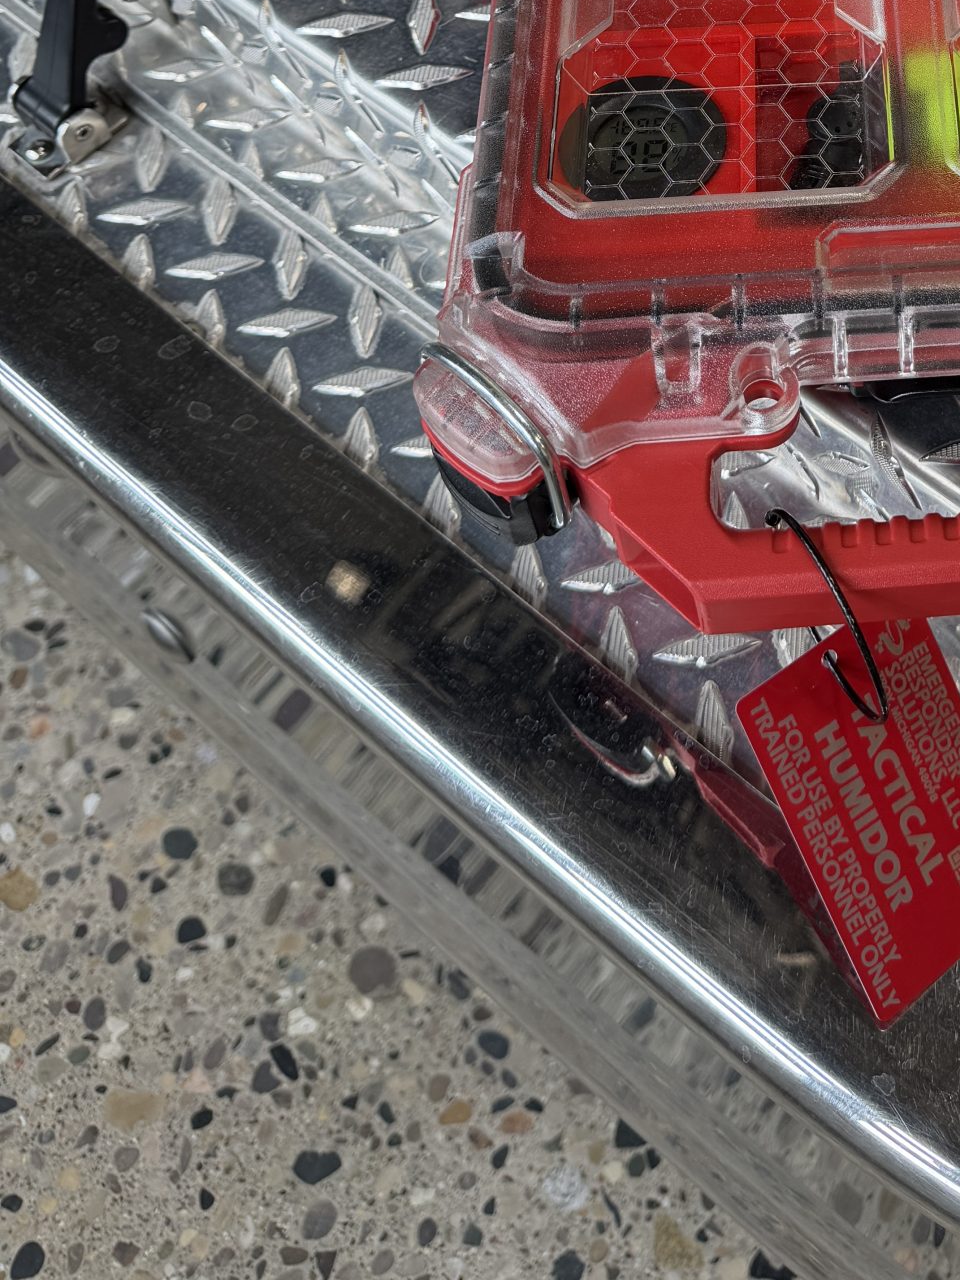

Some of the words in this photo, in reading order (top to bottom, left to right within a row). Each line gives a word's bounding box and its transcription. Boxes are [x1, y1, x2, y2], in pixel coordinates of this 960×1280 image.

[814, 719, 914, 912] HUMIDOR
[851, 692, 944, 887] TACTICAL
[885, 661, 948, 790] SOLUTIONS,
[891, 706, 922, 768] MICHIGAN
[751, 696, 806, 805] TRAINED
[797, 804, 868, 937] PERSONNEL
[861, 945, 901, 1008] ONLY
[778, 713, 811, 768] FOR
[802, 766, 833, 816] USE
[823, 814, 849, 846] BY
[838, 847, 902, 964] PROPERLY
